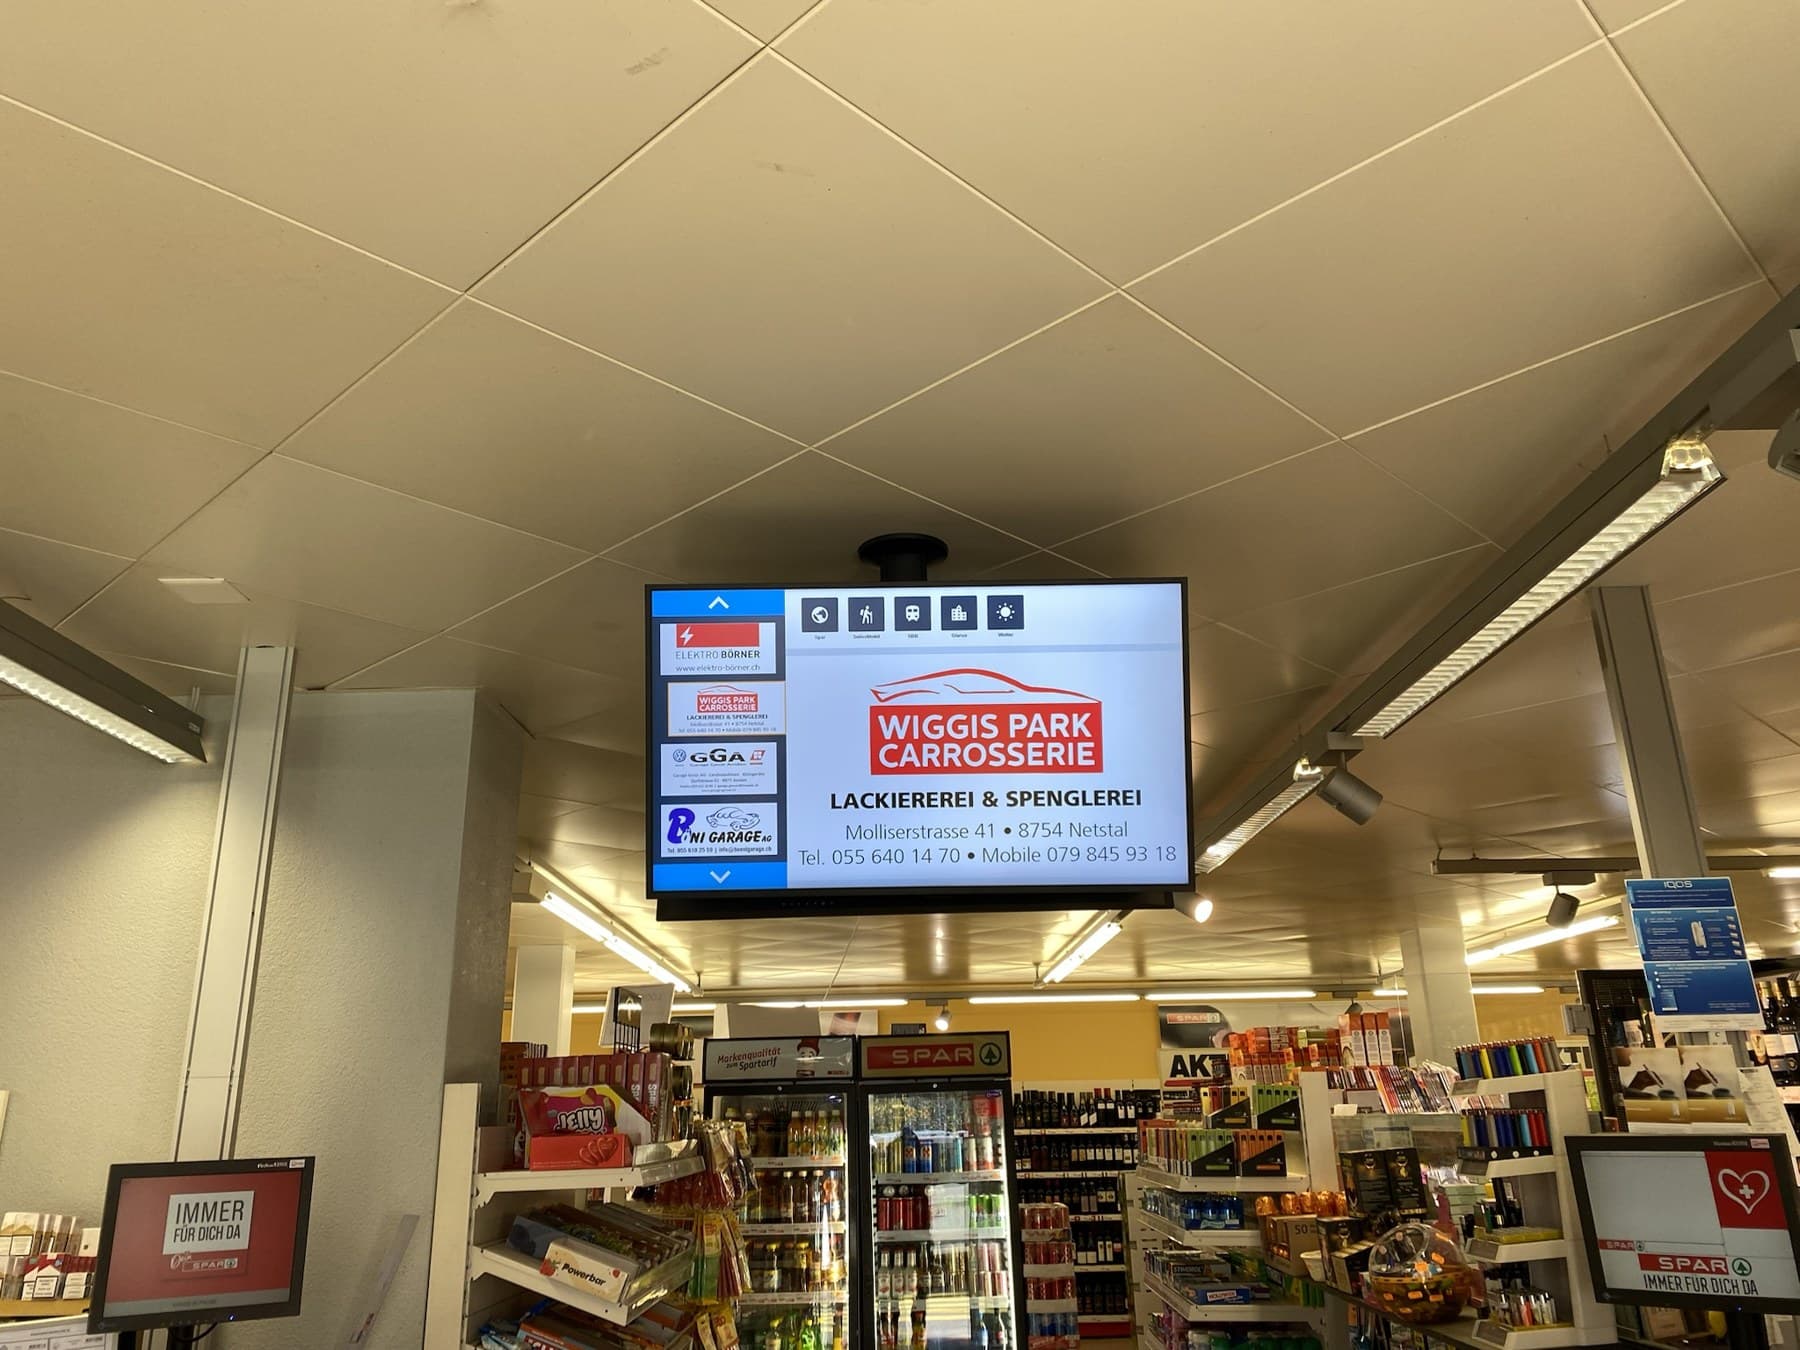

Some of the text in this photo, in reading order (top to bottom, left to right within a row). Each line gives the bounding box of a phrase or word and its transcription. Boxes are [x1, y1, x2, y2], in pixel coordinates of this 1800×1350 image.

[675, 648, 761, 660] ELEKTRO BÖRNER
[699, 696, 756, 705] WIGGIS PARK
[699, 704, 756, 712] CARROSSERIE
[877, 711, 1092, 740] WIGGIS PARK
[690, 748, 745, 763] GGA
[877, 740, 1096, 769] CARROSSERIE
[830, 788, 1142, 810] LACKIEREREI & SPENGLEREI
[709, 830, 762, 843] GARAGE
[762, 835, 772, 843] AG
[845, 820, 1128, 841] Molliserstrasse 41 8754 Netstal
[798, 845, 1177, 865] Tel. 055 640 14 70 Mobile 079 845 93 18
[1663, 880, 1693, 889] IQOS
[1176, 1014, 1207, 1022] SPAR
[717, 1046, 782, 1065] Markenqualität
[738, 1056, 778, 1072] Spartarif
[891, 1047, 973, 1065] SPAR
[1169, 1054, 1229, 1078] AKT
[175, 1200, 244, 1225] IMMER
[173, 1222, 241, 1244] FÜR DICH DA
[1294, 1224, 1308, 1235] 50
[1606, 1240, 1635, 1250] SPAR
[192, 1261, 224, 1270] SPAR
[1658, 1256, 1728, 1273] SPAR
[561, 1262, 607, 1286] Powerbar
[1643, 1274, 1683, 1292] IMMER
[1712, 1278, 1740, 1294] DICH
[1742, 1279, 1759, 1296] DA
